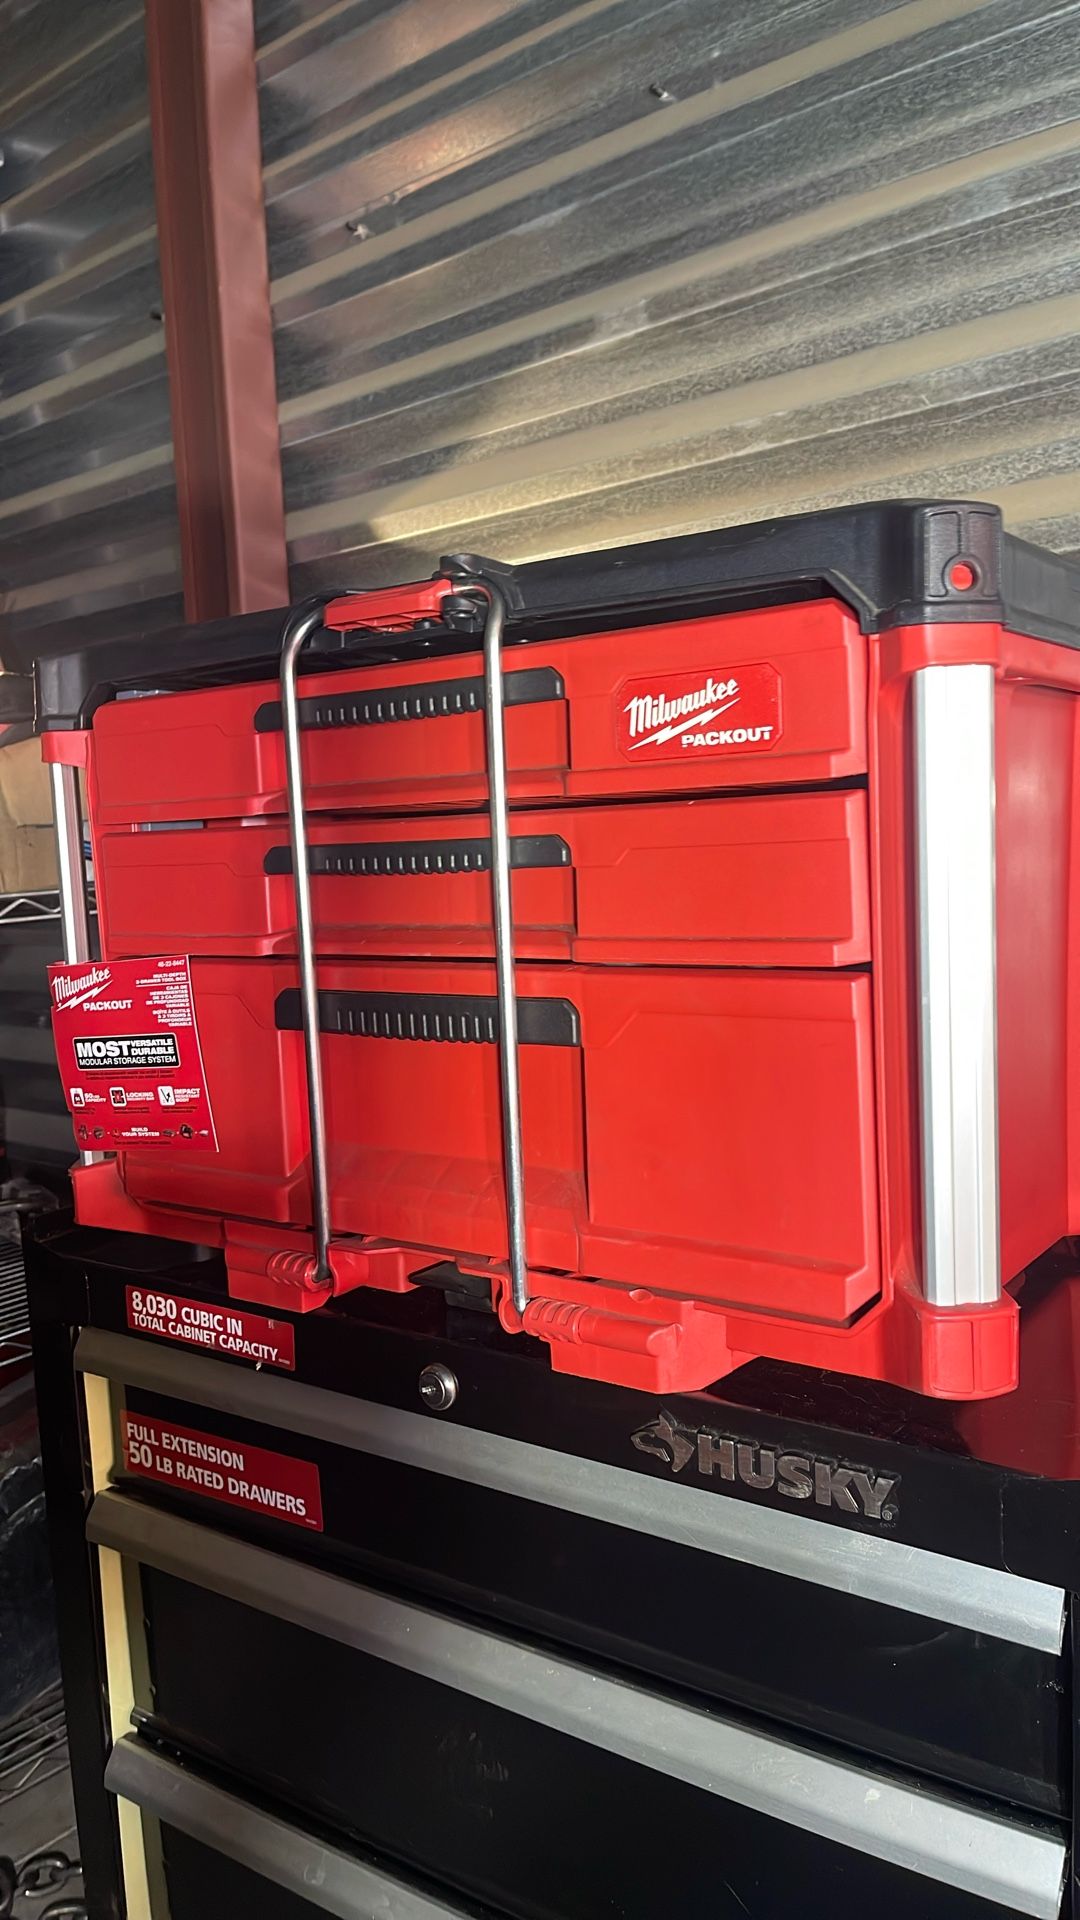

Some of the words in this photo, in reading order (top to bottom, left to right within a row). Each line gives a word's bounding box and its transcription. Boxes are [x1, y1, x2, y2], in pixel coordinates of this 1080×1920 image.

[623, 678, 740, 737] Milwaukee
[682, 726, 773, 747] PACKOUT
[51, 967, 111, 1002] Milwaukee
[83, 1000, 132, 1011] PACKOUT
[76, 1041, 130, 1058] MOST
[131, 1038, 173, 1047] VERSATILE
[80, 1058, 113, 1066] MODULAR
[114, 1056, 147, 1064] STORAGE
[131, 1047, 174, 1055] DURABLE
[132, 1292, 176, 1319] 8,030
[182, 1307, 224, 1331] CUBIC
[227, 1318, 242, 1336] IN
[133, 1313, 166, 1332] TOTAL
[169, 1322, 217, 1344] CABINET
[219, 1335, 278, 1361] CAPACITY
[127, 1422, 159, 1446] FULL
[162, 1432, 244, 1471] EXTENSION
[129, 1441, 152, 1468] 50
[156, 1455, 173, 1474] LB
[176, 1463, 224, 1490] RATED
[228, 1478, 306, 1516] DRAWERS
[697, 1433, 896, 1519] HUSKY
